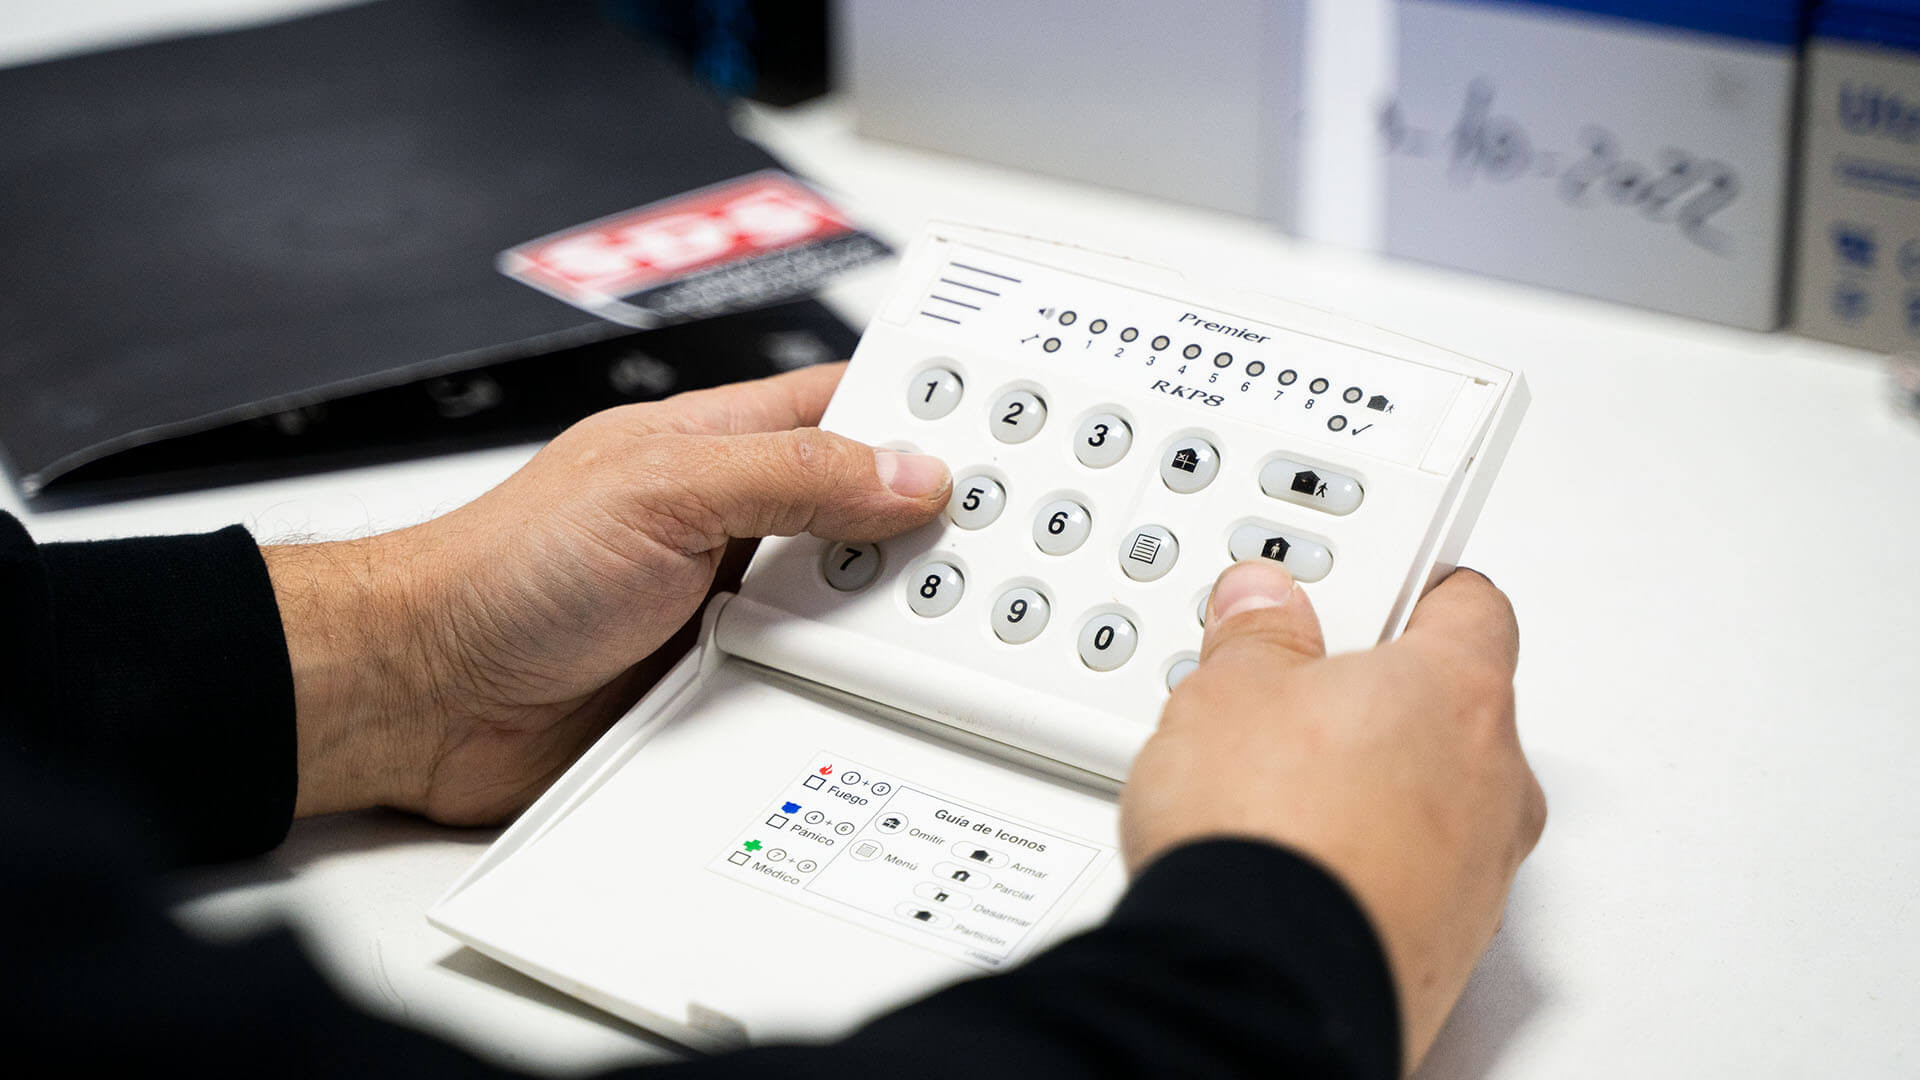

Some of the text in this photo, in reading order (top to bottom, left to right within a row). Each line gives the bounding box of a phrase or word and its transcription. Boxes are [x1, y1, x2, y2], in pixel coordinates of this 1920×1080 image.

[1178, 312, 1271, 345] Premier
[1086, 340, 1314, 409] 1 2 3 4 5 6 7 8
[1151, 377, 1224, 406] RKP8
[925, 381, 1108, 447] 1 2 3
[963, 488, 1068, 534] 5 6
[840, 547, 1114, 650] 7 8 9 0
[827, 785, 868, 806] Fuego
[908, 827, 946, 845] Omitir
[935, 810, 1046, 852] Guía de Iconos
[1010, 863, 1048, 878] Armar
[992, 883, 1034, 901] Parcial
[973, 904, 1031, 927] Desarmar
